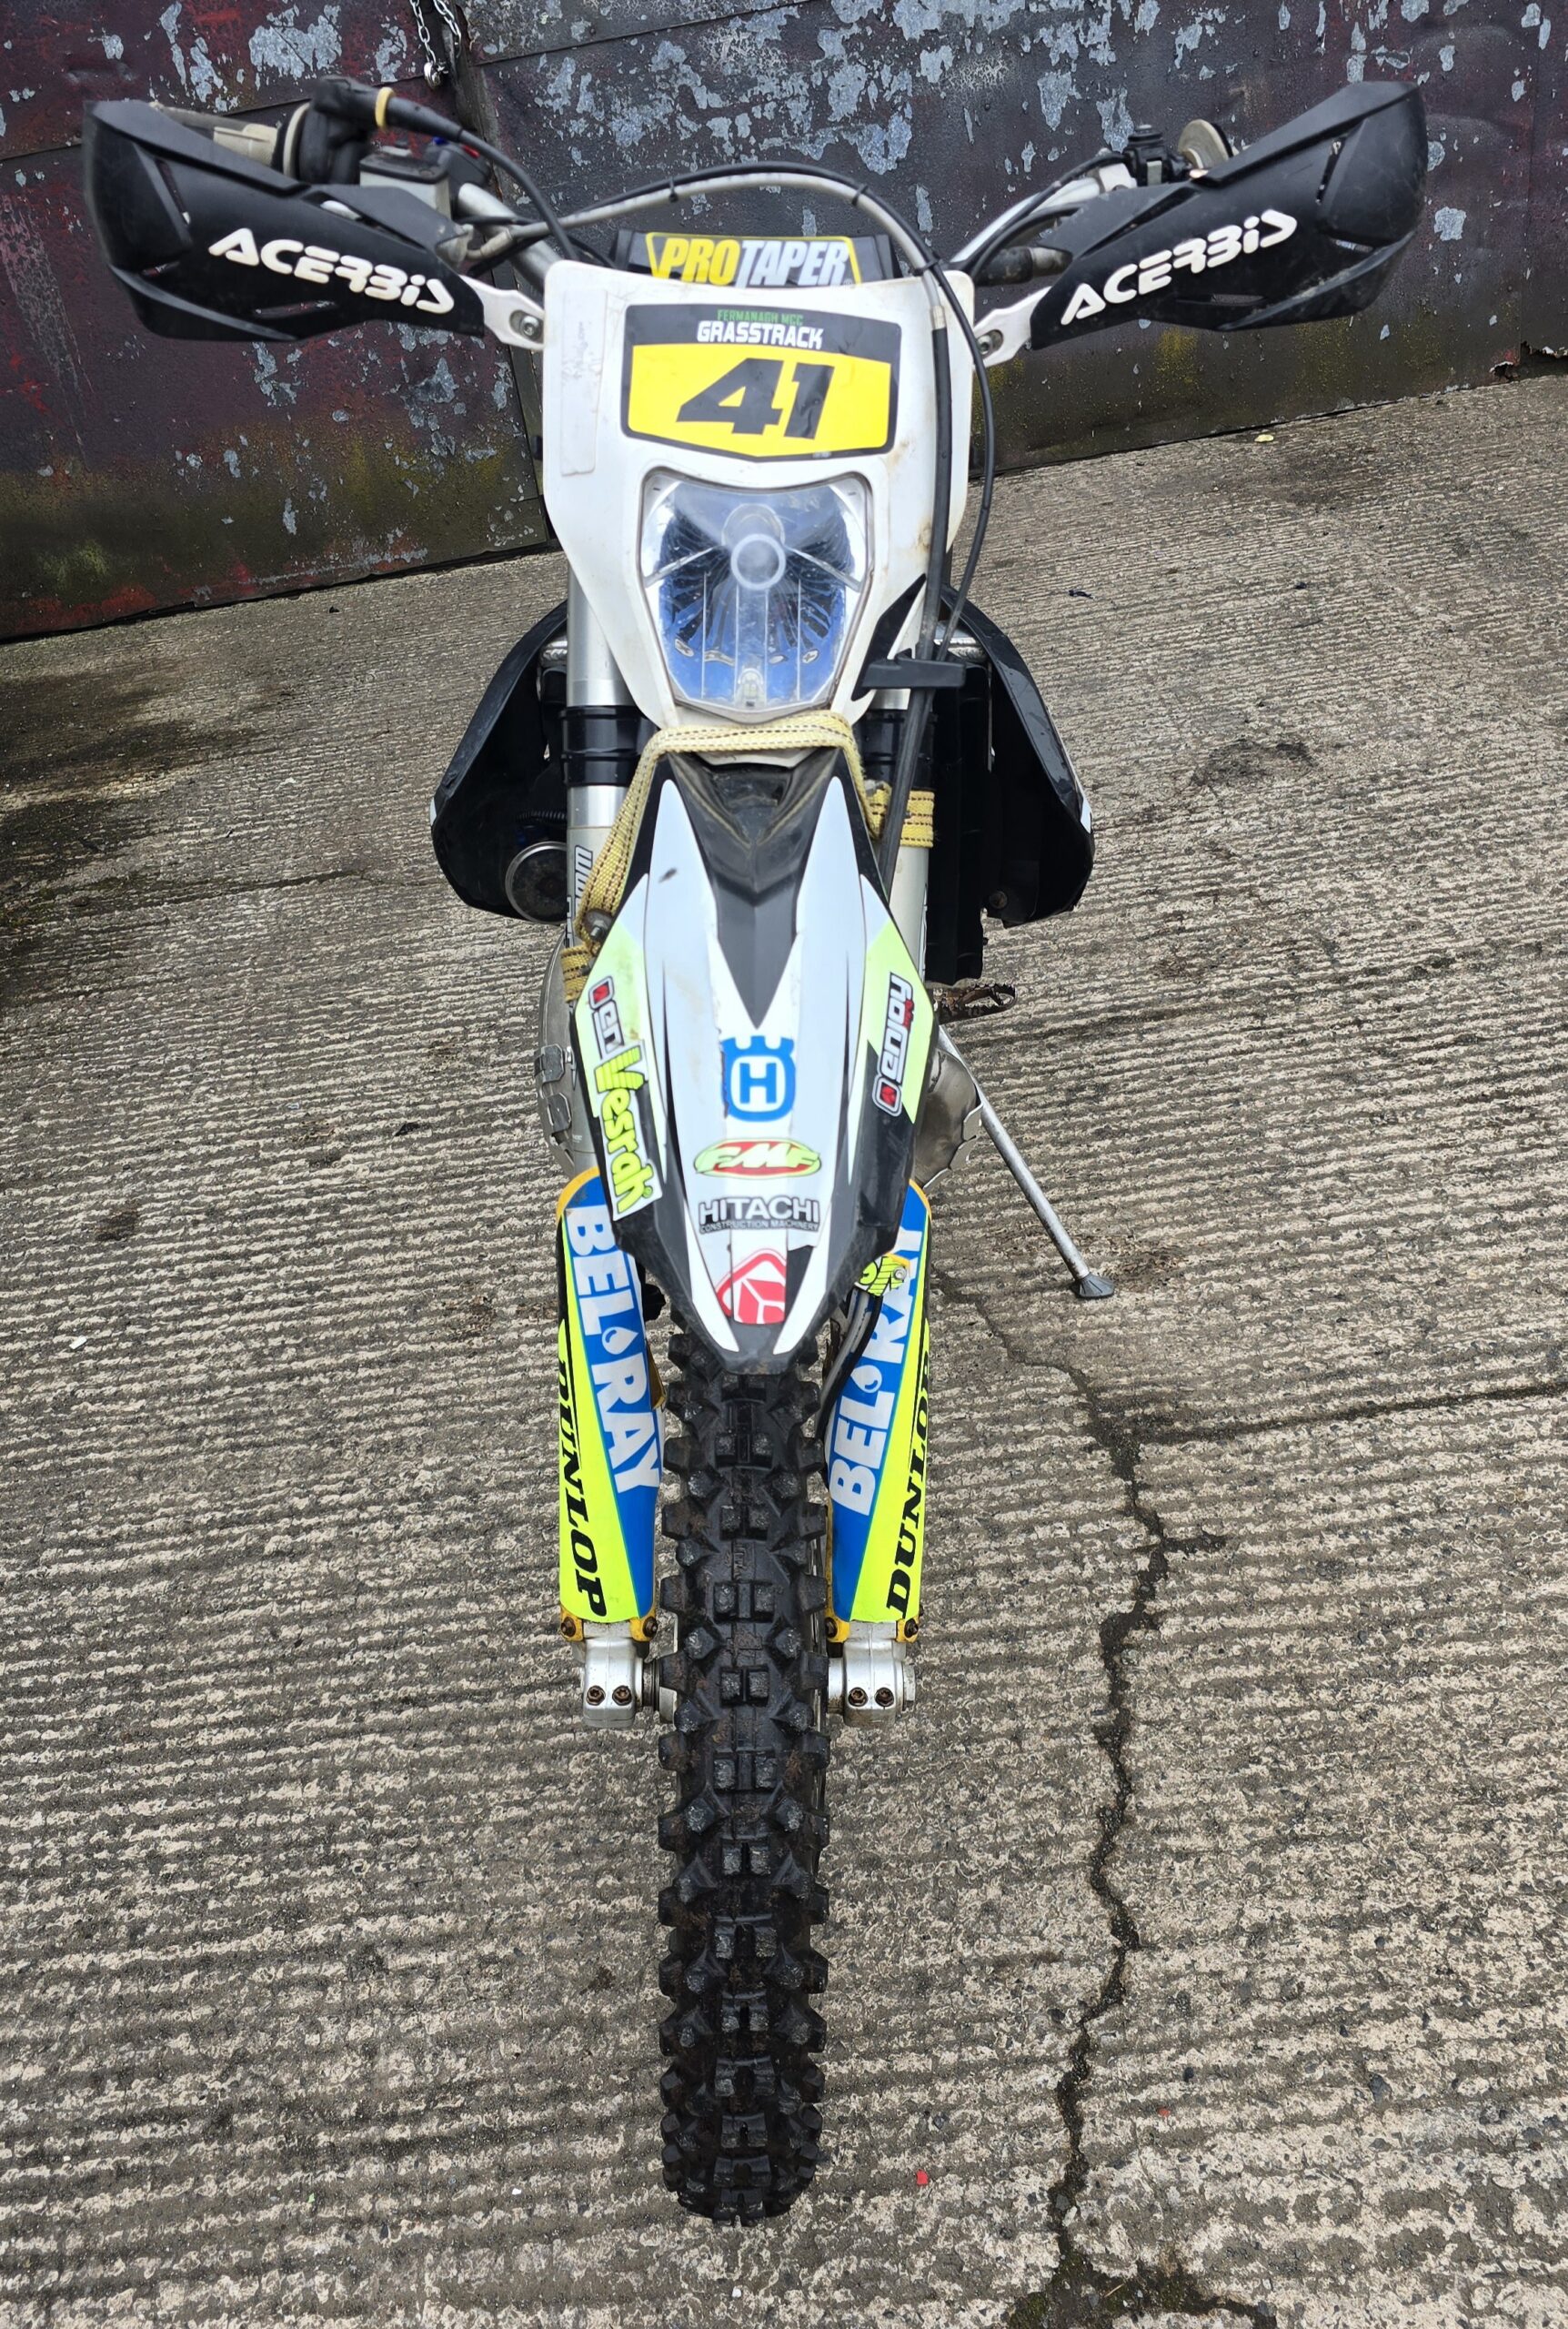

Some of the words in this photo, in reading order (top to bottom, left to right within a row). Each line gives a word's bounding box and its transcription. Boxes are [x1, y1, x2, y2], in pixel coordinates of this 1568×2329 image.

[717, 309, 779, 324] FERMANAGH
[781, 313, 804, 327] MCC
[697, 320, 824, 350] GRASSTRACK
[676, 358, 835, 439] 41
[594, 1045, 654, 1215] Vesrah
[696, 1141, 820, 1174] FMF
[699, 1195, 819, 1225] HITACHI
[699, 1218, 769, 1235] CONSTRUCTION
[769, 1220, 819, 1232] MACHINERY
